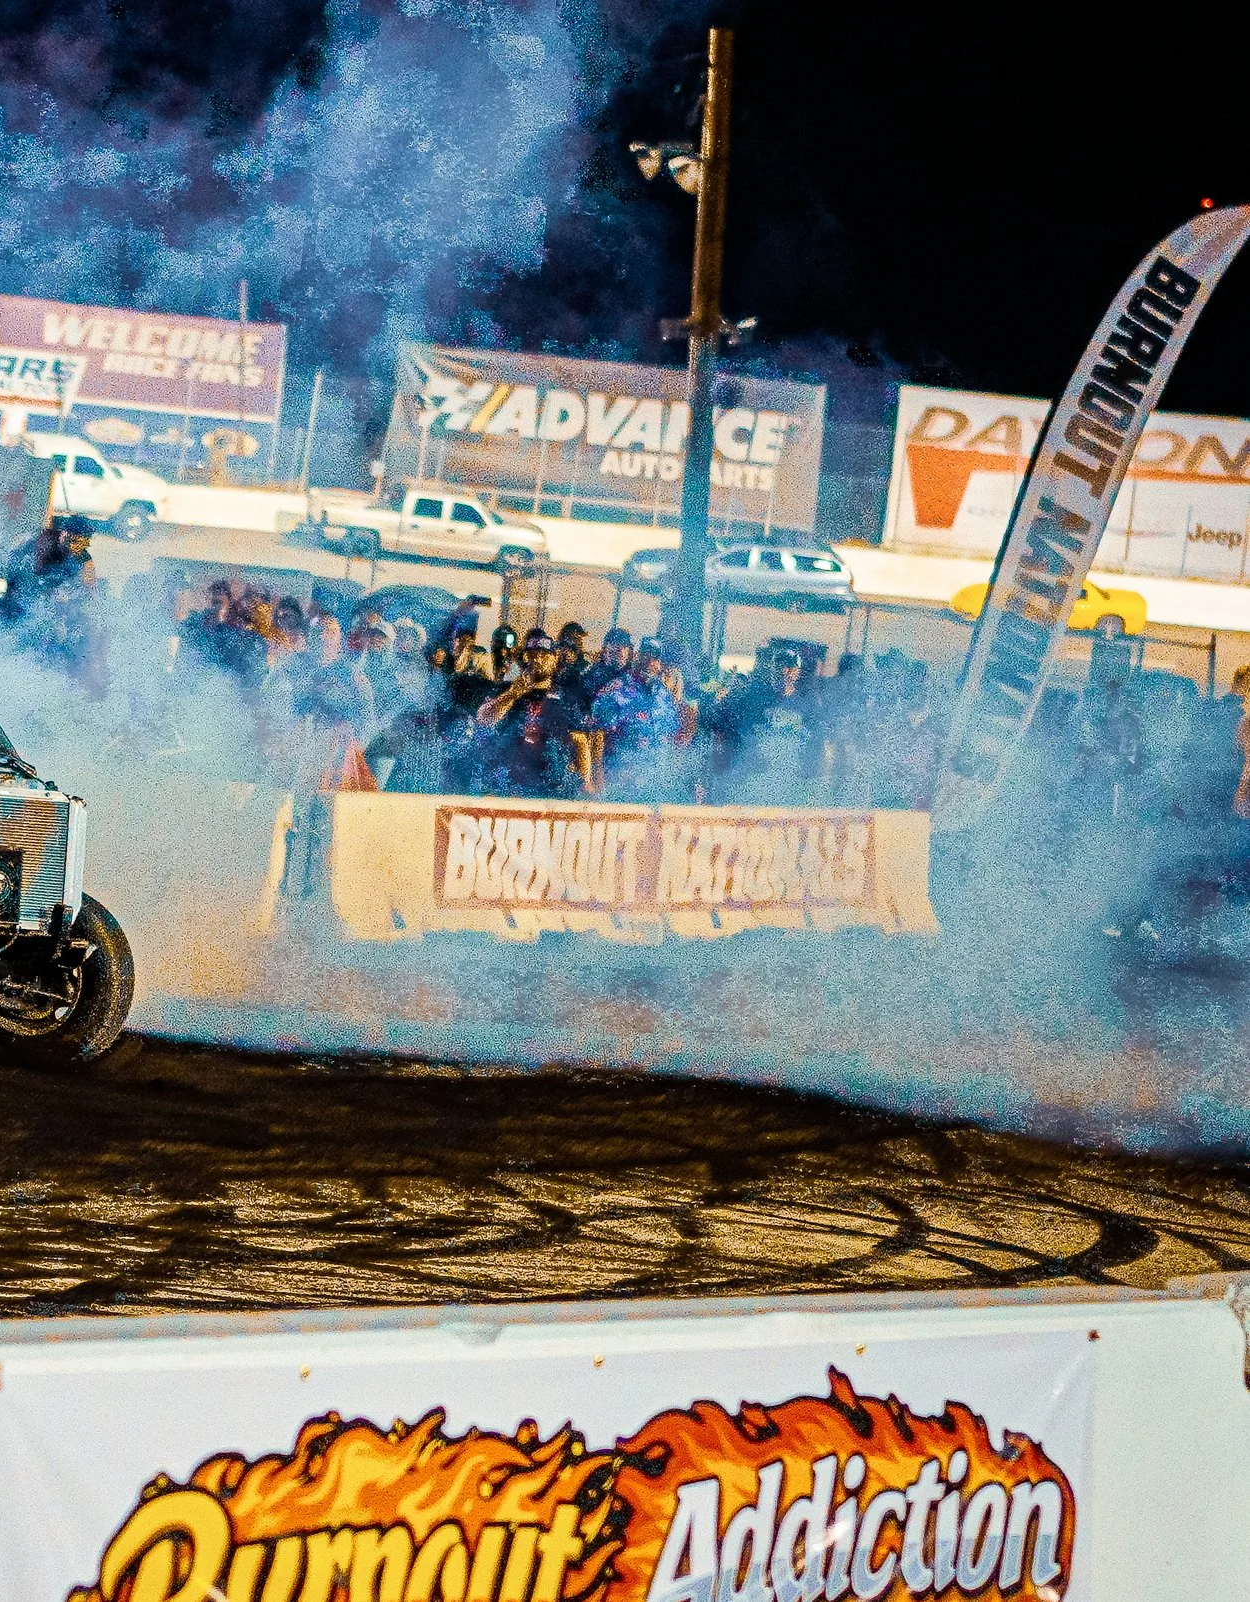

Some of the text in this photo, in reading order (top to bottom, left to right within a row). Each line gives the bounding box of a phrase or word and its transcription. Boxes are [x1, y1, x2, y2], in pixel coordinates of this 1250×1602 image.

[42, 313, 263, 364] WELCOME
[1053, 255, 1202, 500] BURNOUT
[599, 450, 776, 491] AUTO ARTS
[1186, 522, 1243, 551] Jeep
[444, 813, 868, 903] BURNOUT NATIONALS
[645, 1448, 1061, 1602] Addiction
